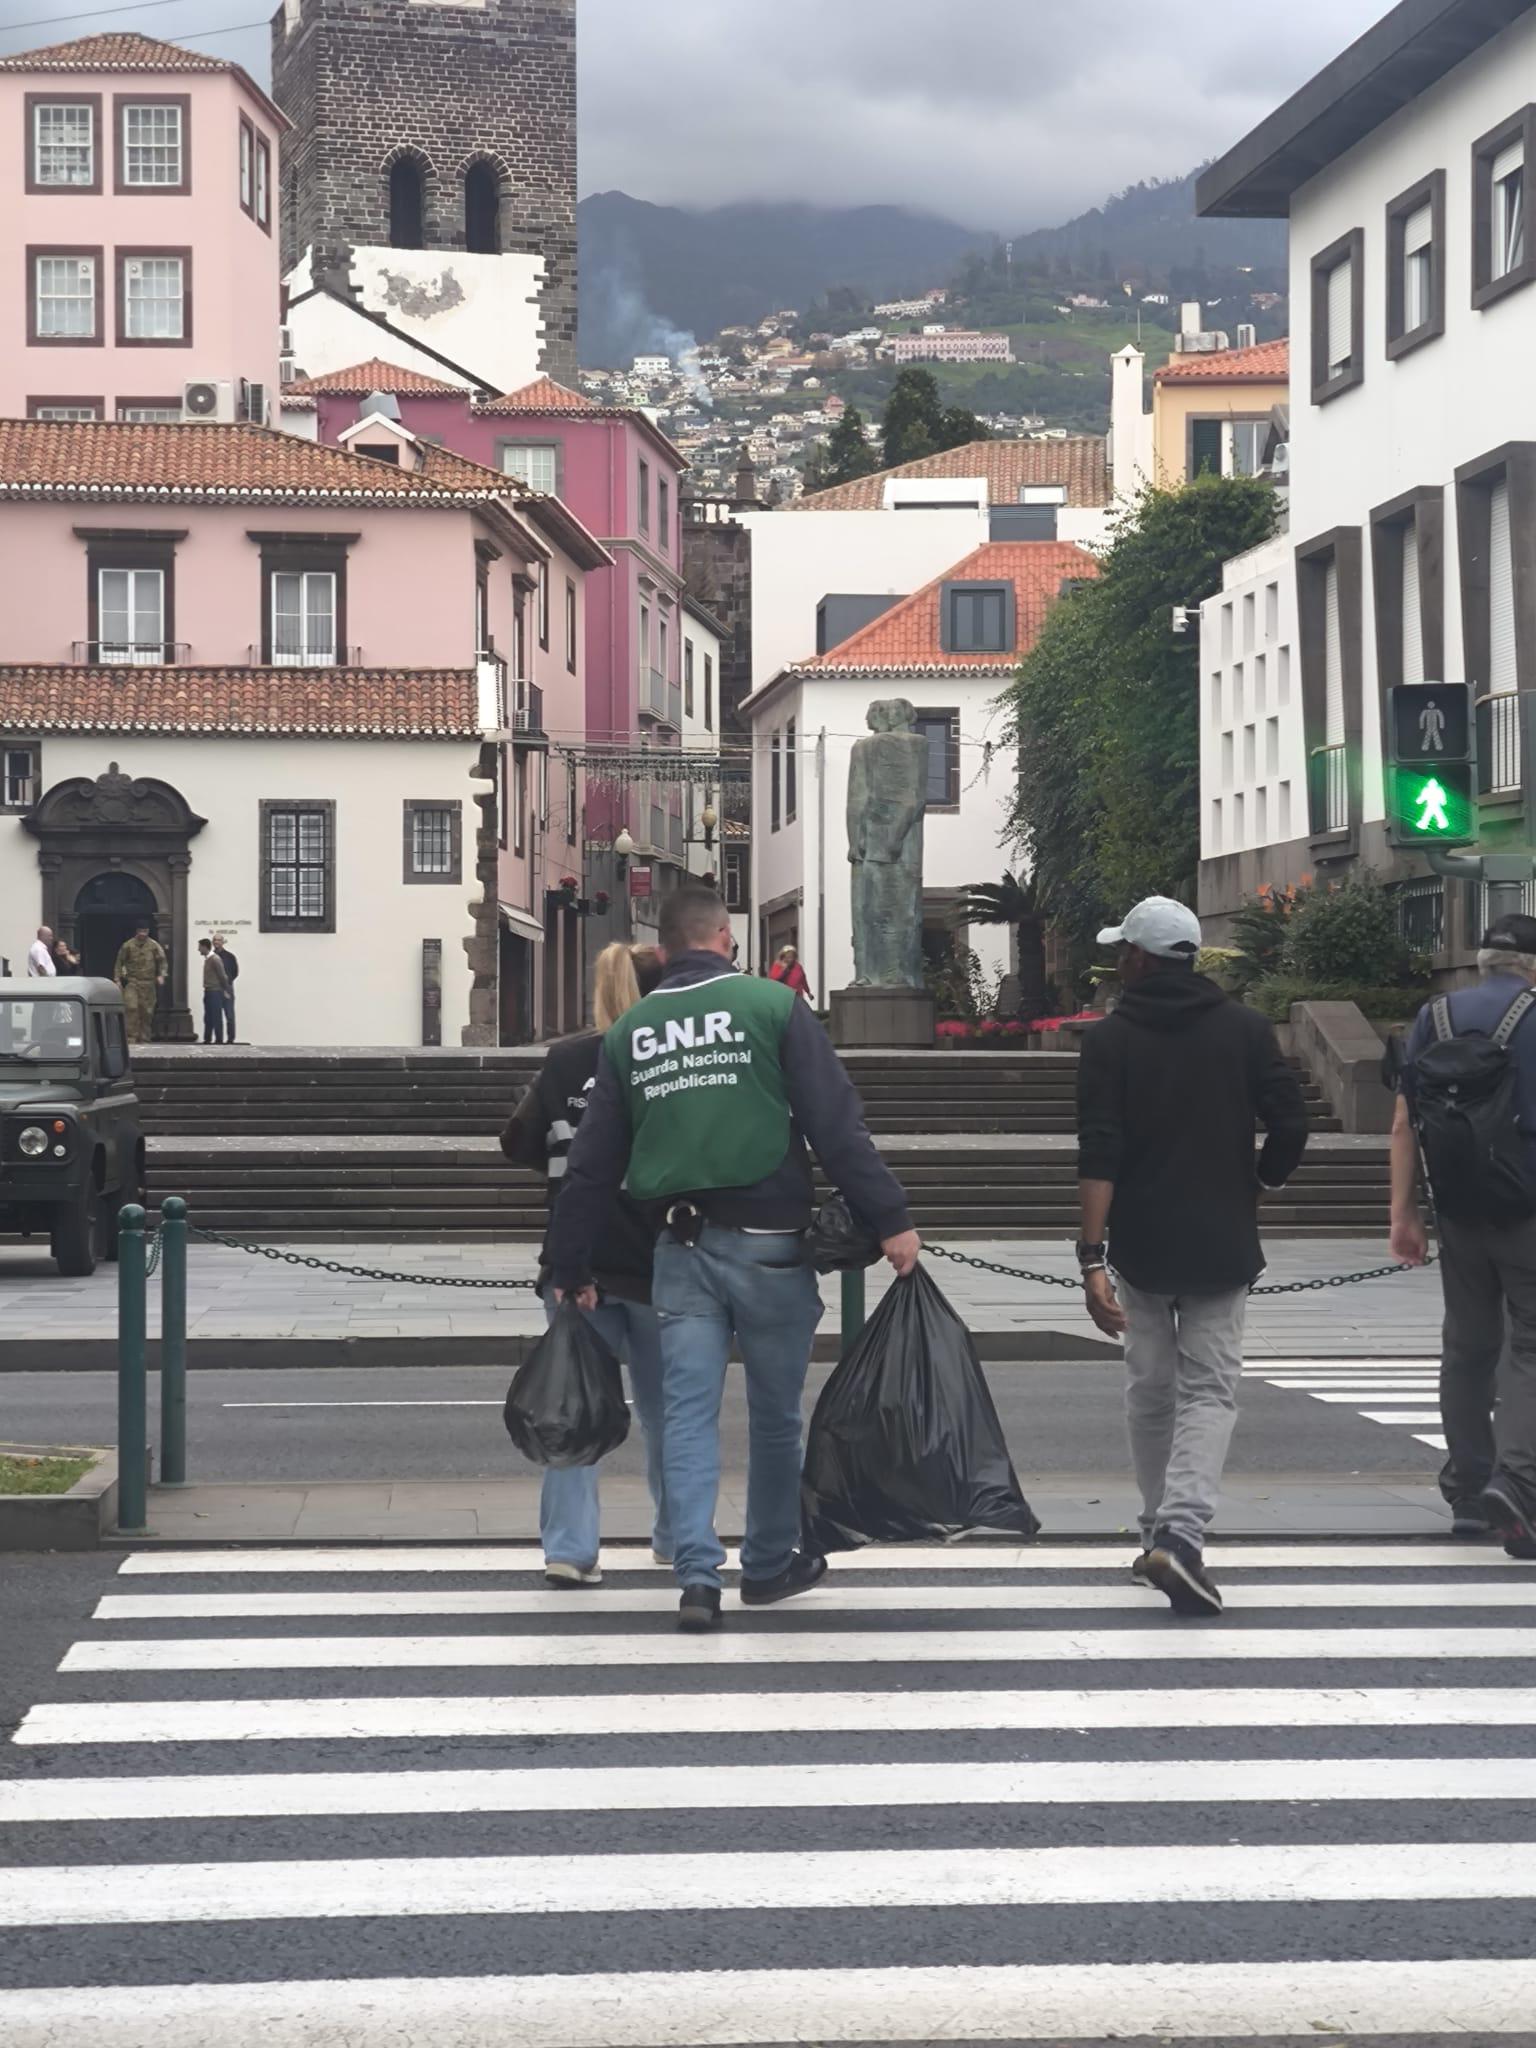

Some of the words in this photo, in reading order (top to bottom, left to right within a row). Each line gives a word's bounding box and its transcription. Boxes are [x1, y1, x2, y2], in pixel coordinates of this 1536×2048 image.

[632, 1011, 745, 1060] G.N.R.
[631, 1059, 679, 1086] Guarda
[683, 1050, 752, 1068] Nacional
[644, 1072, 737, 1100] Republicana
